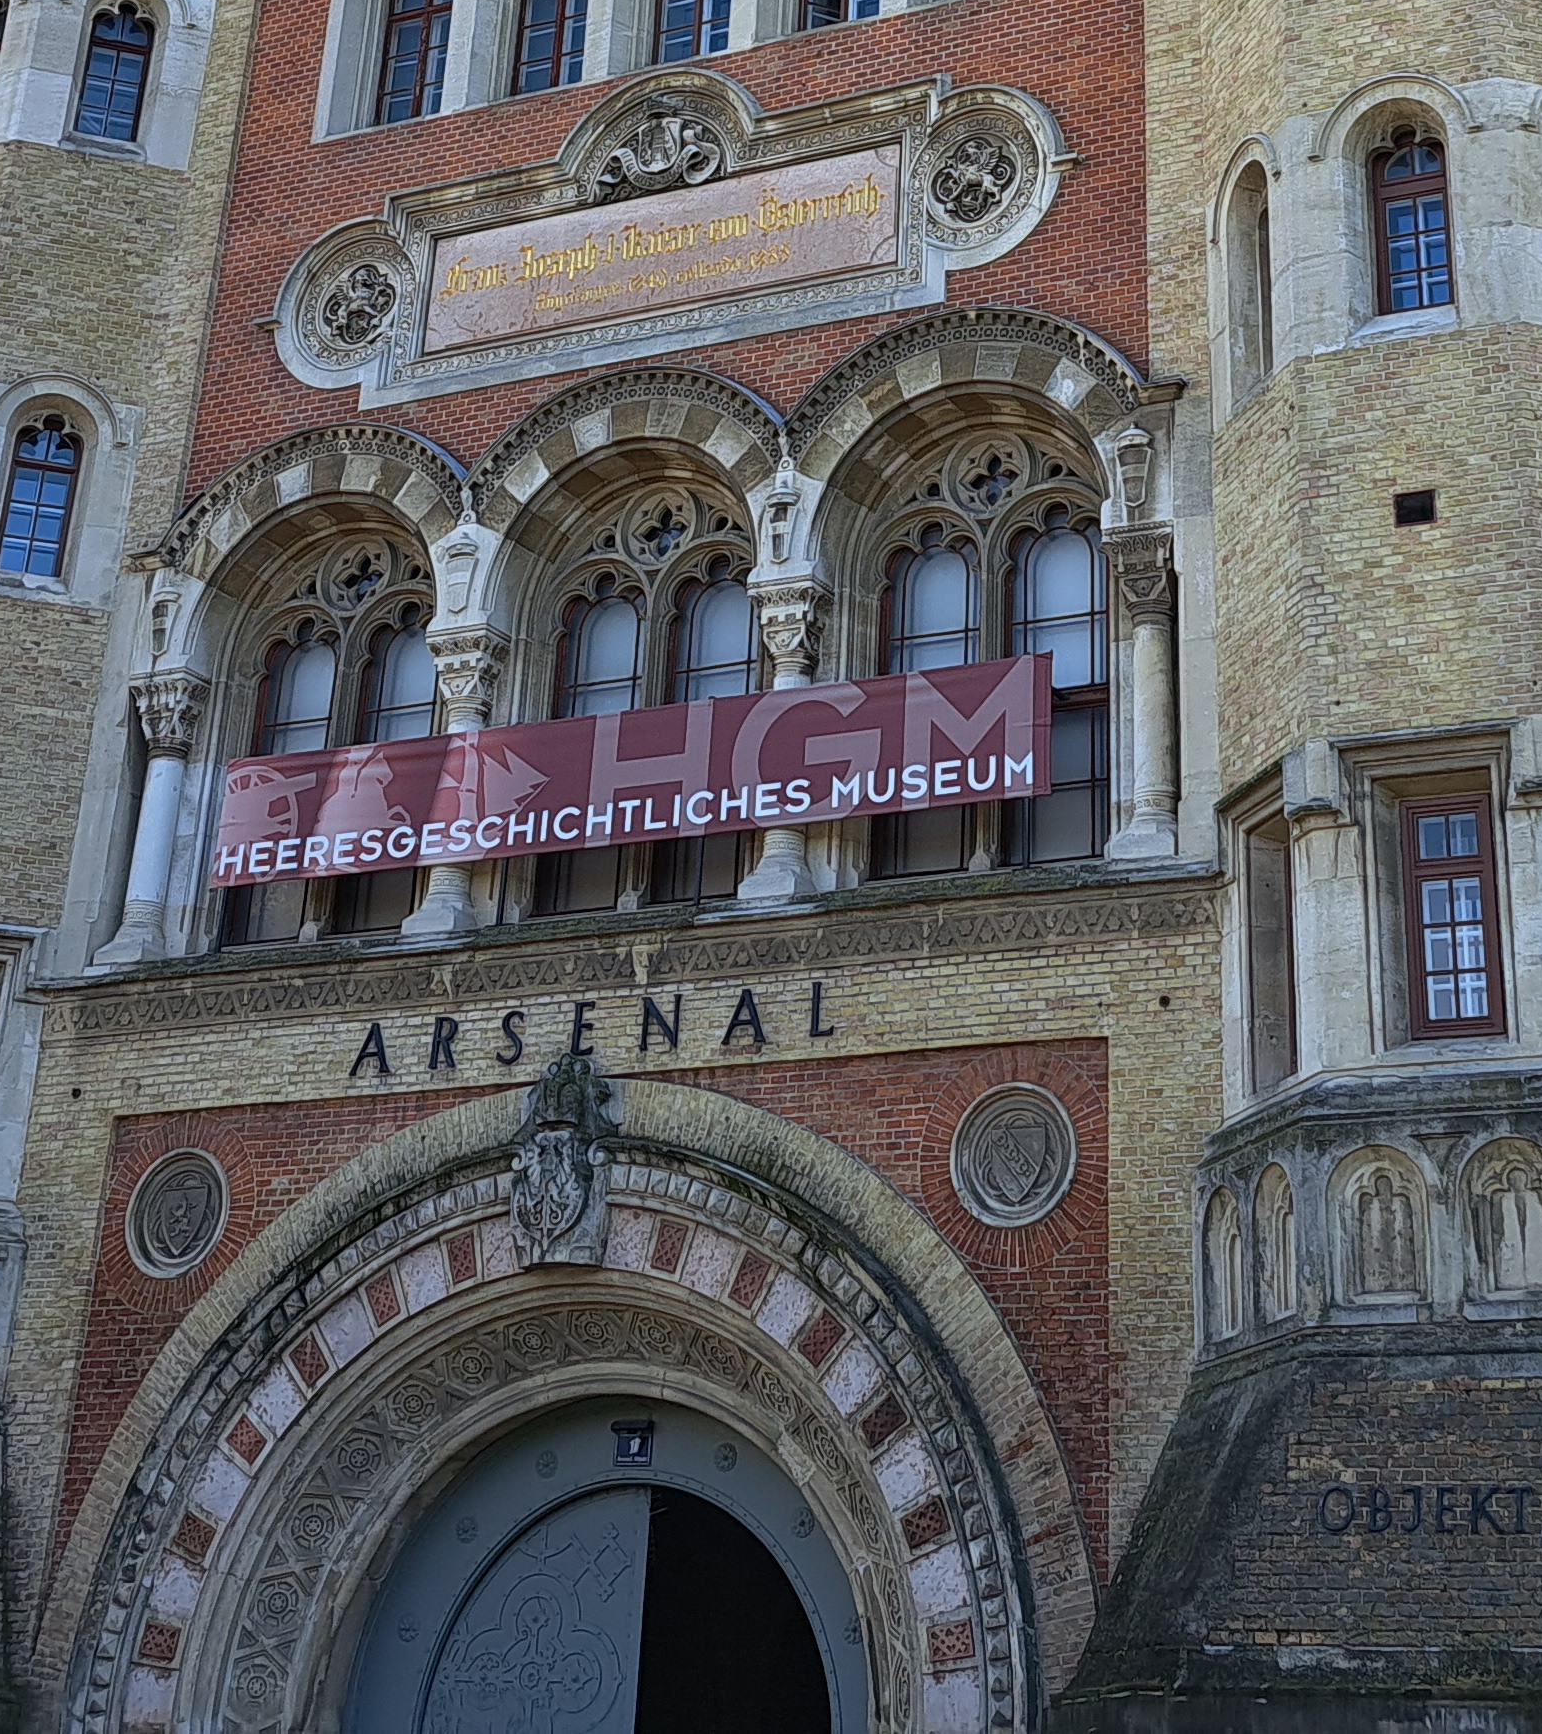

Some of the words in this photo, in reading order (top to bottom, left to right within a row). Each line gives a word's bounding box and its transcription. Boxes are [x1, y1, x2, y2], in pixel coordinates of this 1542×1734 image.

[585, 654, 1034, 848] HGM
[218, 778, 811, 876] HEERESGESCHICHTLICHES
[831, 751, 1034, 809] MUSEUM
[349, 980, 834, 1077] ARSENAL
[1318, 1484, 1534, 1535] OBJEKT
